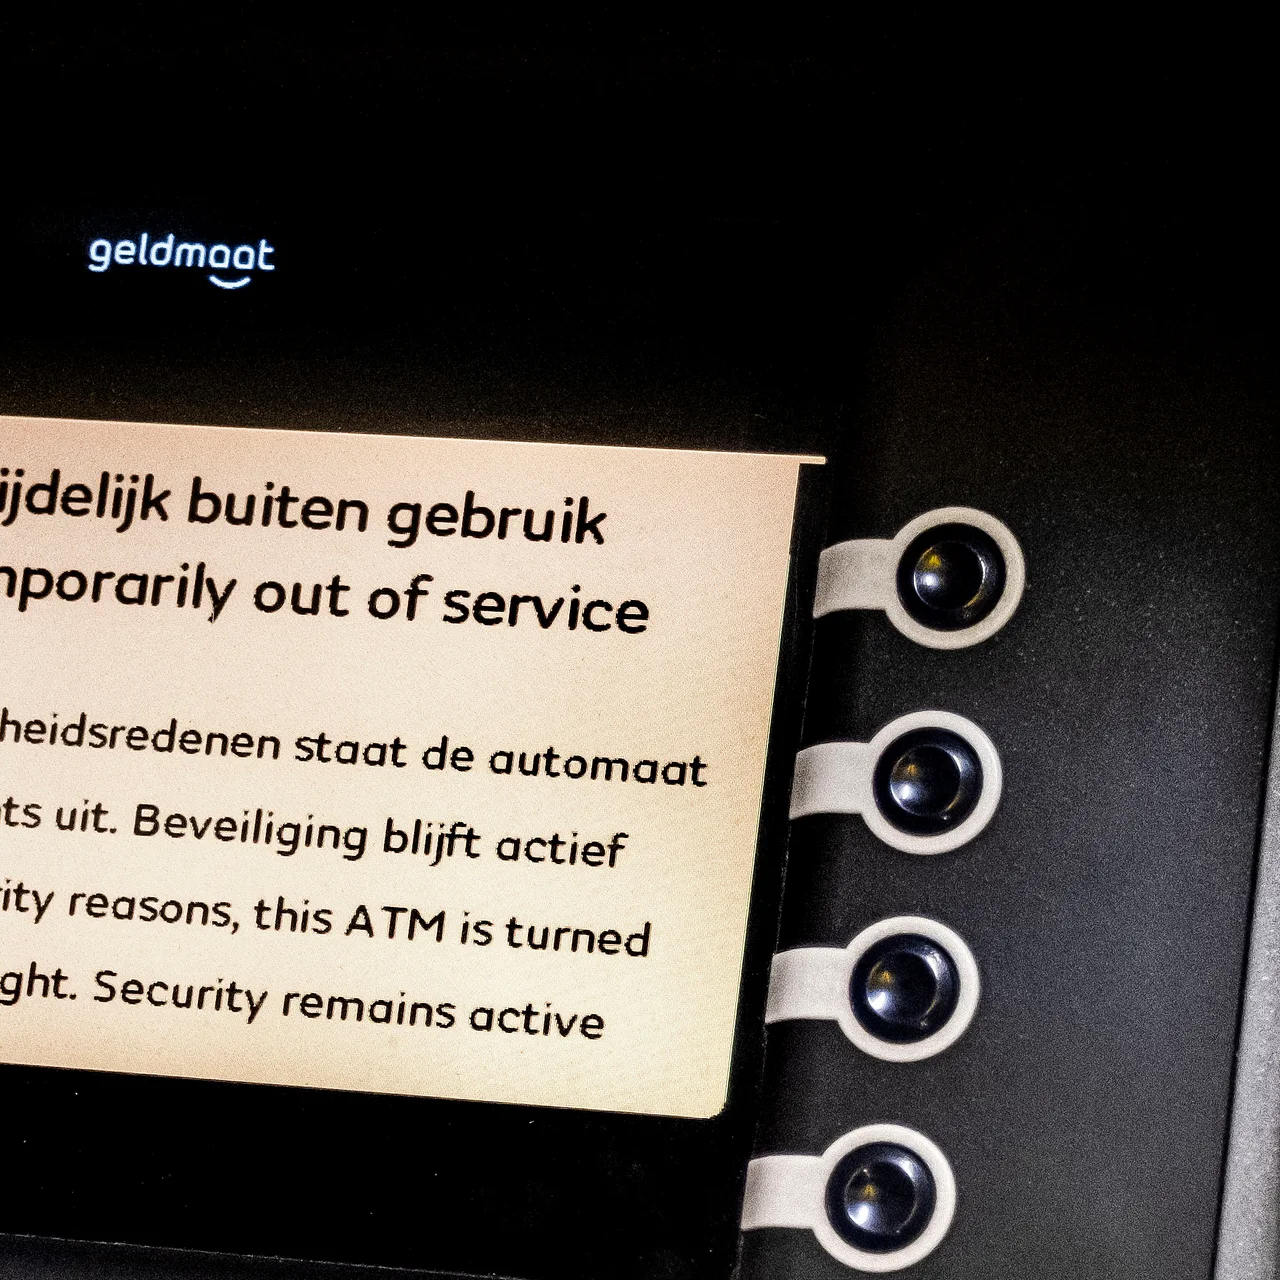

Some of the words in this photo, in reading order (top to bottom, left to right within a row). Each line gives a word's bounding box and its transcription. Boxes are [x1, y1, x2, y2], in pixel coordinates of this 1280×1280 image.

[88, 232, 275, 272] geldmaat
[188, 476, 369, 532] buiten
[387, 490, 607, 548] gebruik
[254, 575, 350, 617] out
[368, 574, 434, 621] of
[443, 584, 649, 634] service
[295, 732, 407, 768] staat
[422, 735, 474, 772] de
[489, 746, 708, 787] automaat
[56, 800, 117, 834] uit.
[134, 804, 367, 861] Beveiliging
[384, 817, 481, 867] blijft
[496, 832, 629, 868] actief
[69, 893, 239, 935] reasons,
[254, 896, 332, 934] this
[344, 905, 445, 942] ATM
[461, 911, 493, 946] is
[506, 917, 651, 957] turned
[94, 970, 268, 1024] Security
[283, 992, 456, 1028] remains
[469, 1003, 604, 1040] active
